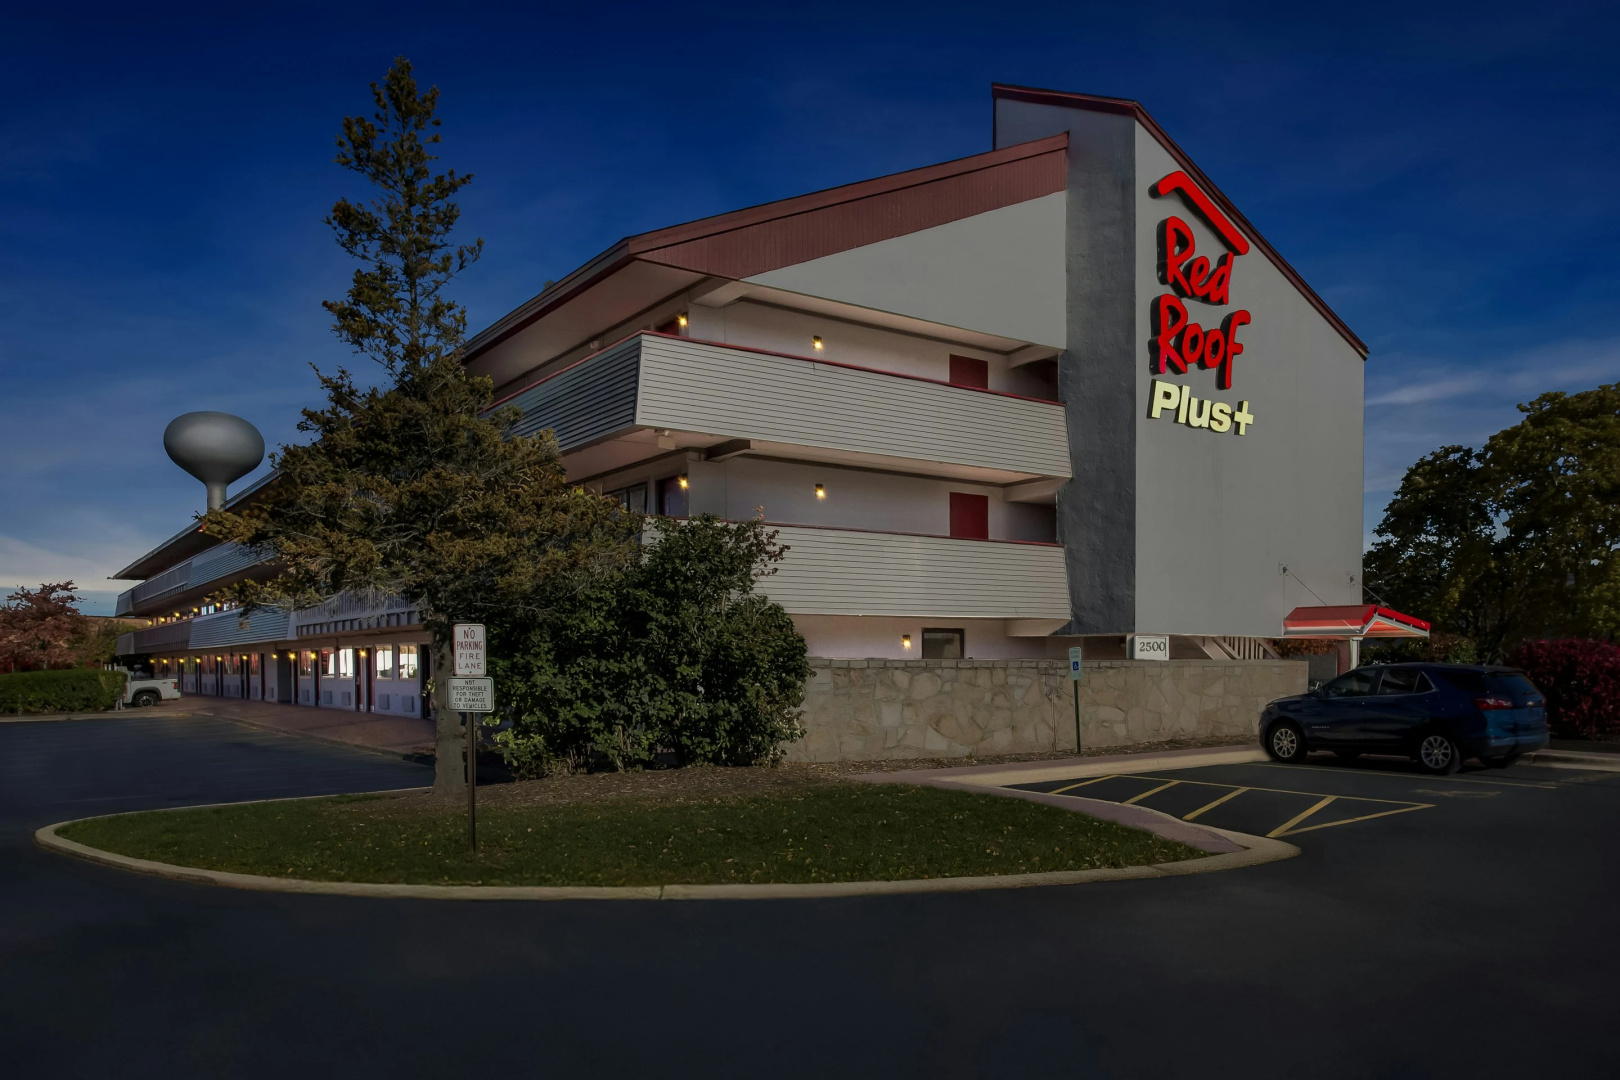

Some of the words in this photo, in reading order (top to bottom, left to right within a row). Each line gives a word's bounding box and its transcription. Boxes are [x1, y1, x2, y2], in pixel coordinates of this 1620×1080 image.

[1163, 215, 1235, 305] Red
[1156, 293, 1251, 390] Roof
[1151, 380, 1254, 436] Plus+
[456, 641, 483, 651] PARKING
[463, 630, 475, 640] NO
[1139, 641, 1166, 652] 2500
